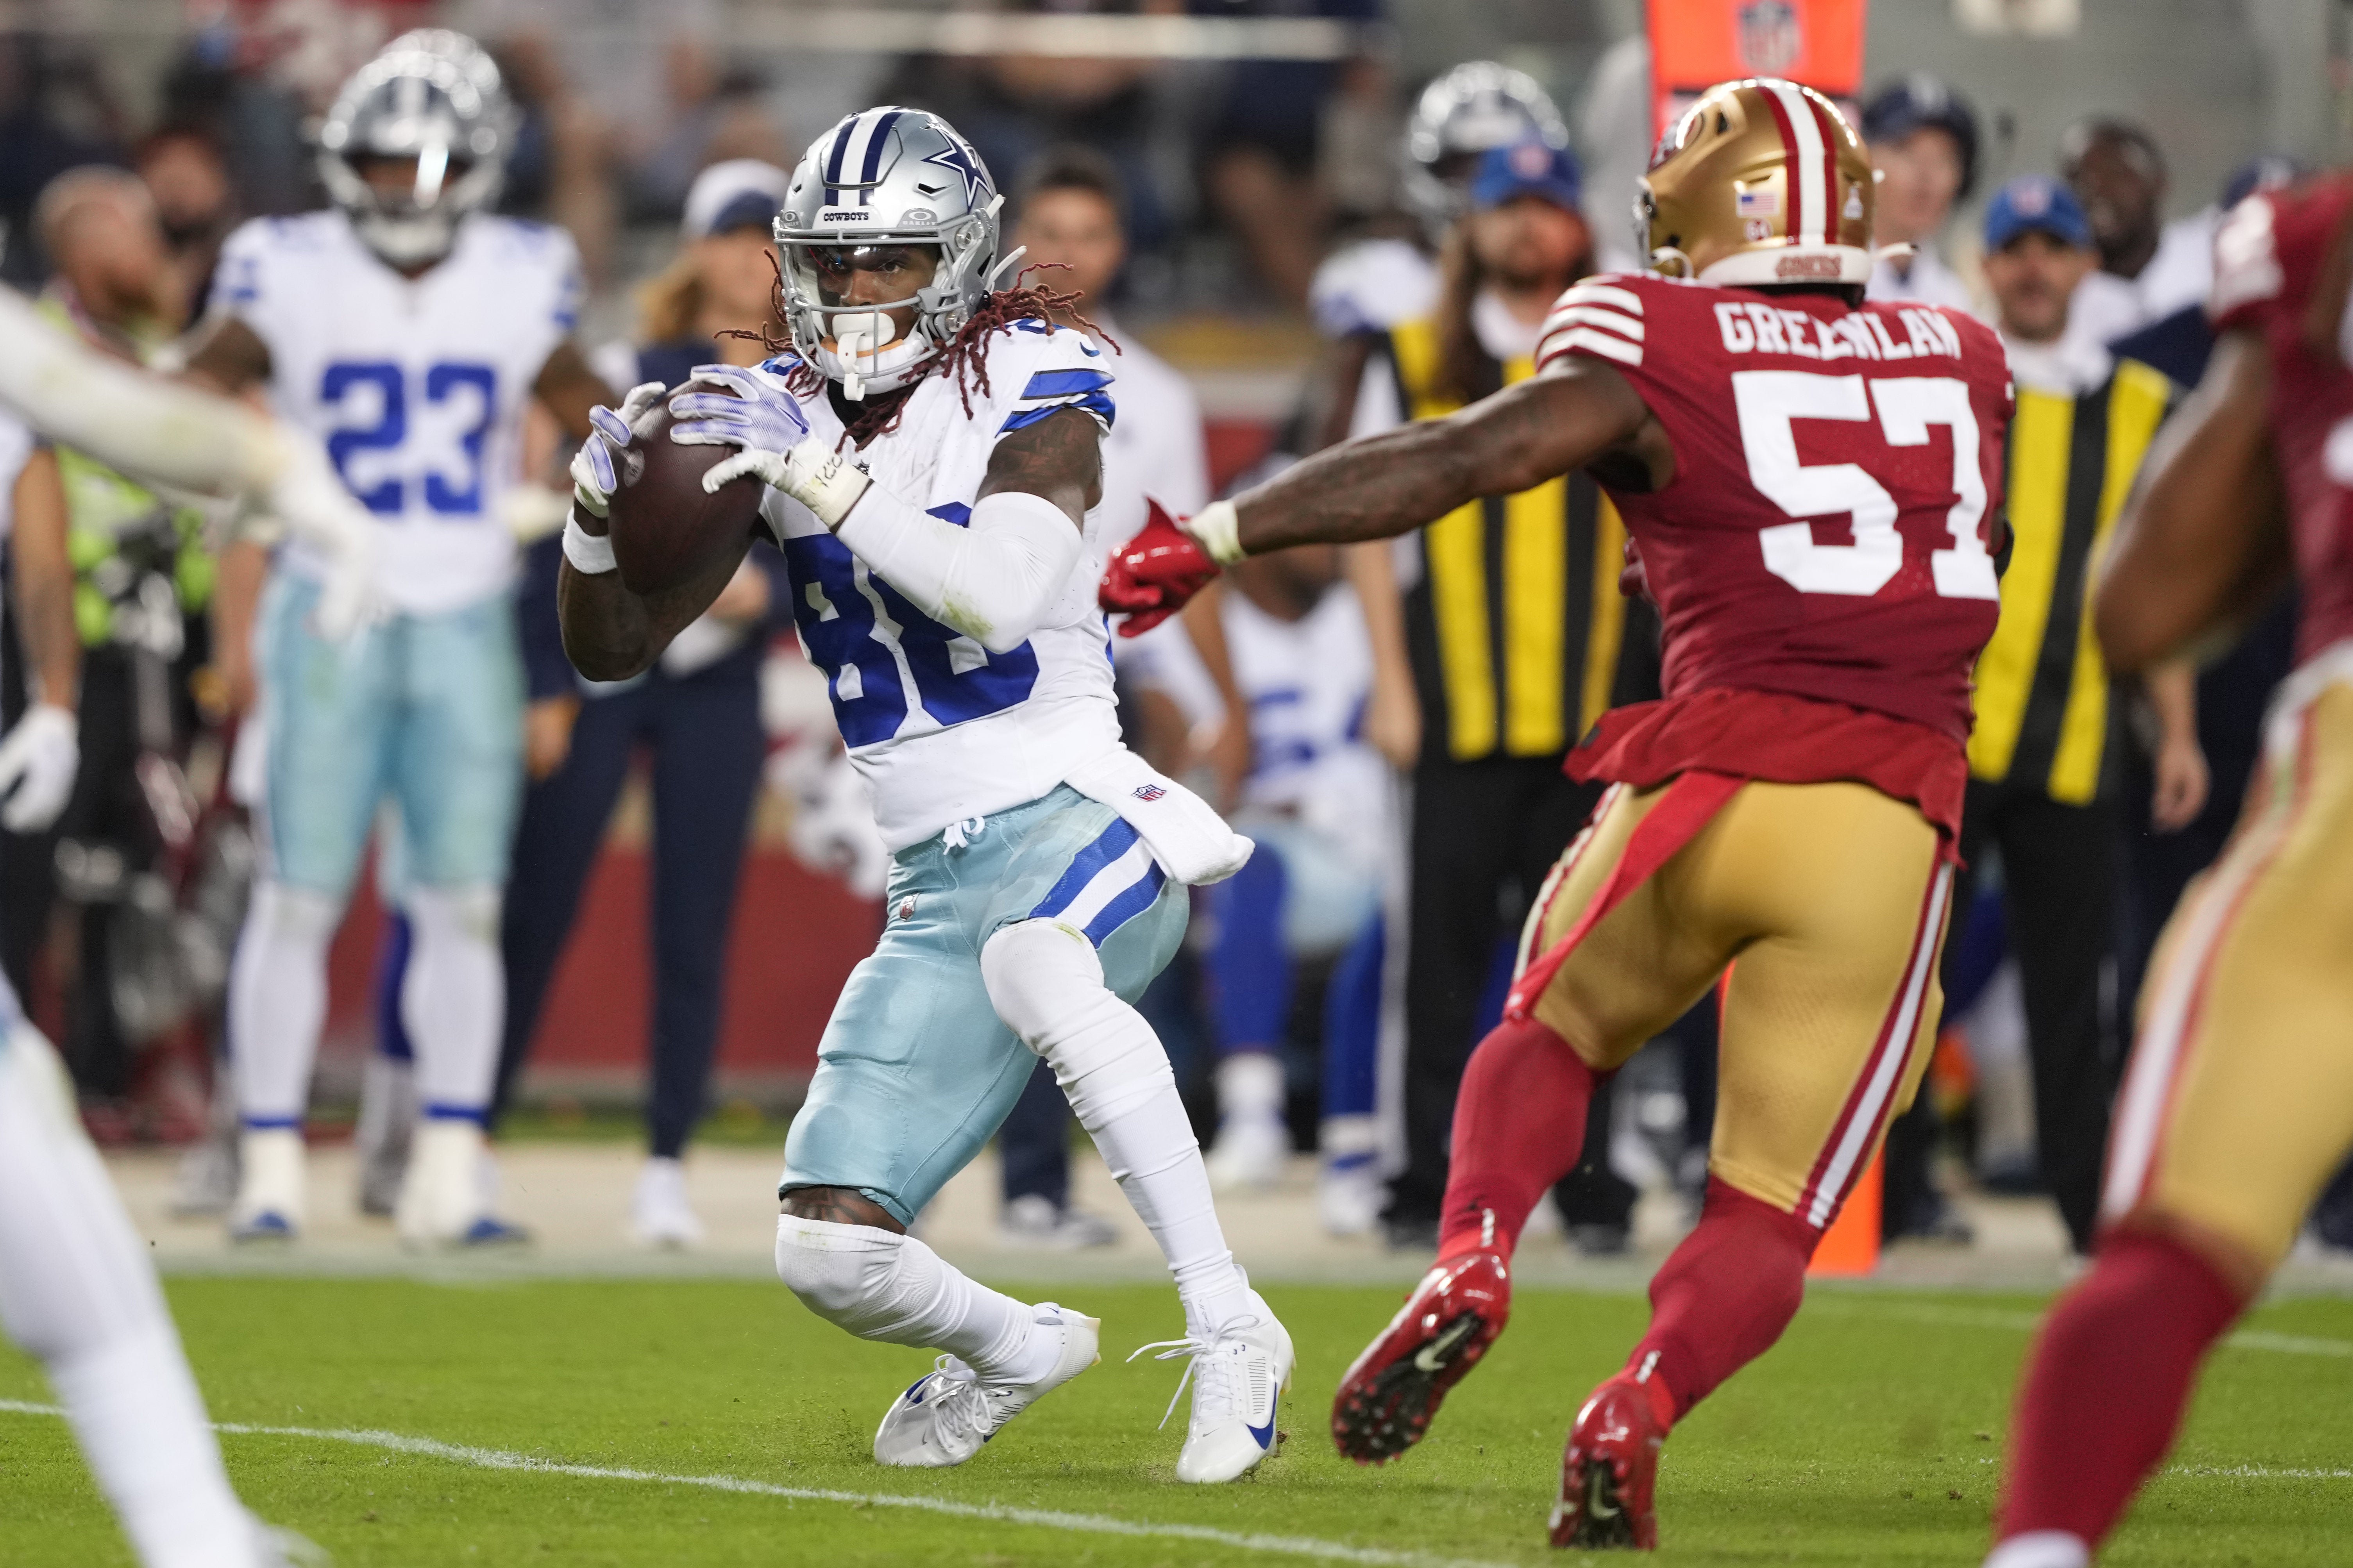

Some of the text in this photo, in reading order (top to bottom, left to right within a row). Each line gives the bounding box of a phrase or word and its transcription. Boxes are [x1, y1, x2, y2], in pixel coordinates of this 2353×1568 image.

[824, 212, 869, 221] COWBOYS
[321, 360, 495, 515] 23
[1731, 370, 2000, 601] 57
[1139, 790, 1165, 801] NFL
